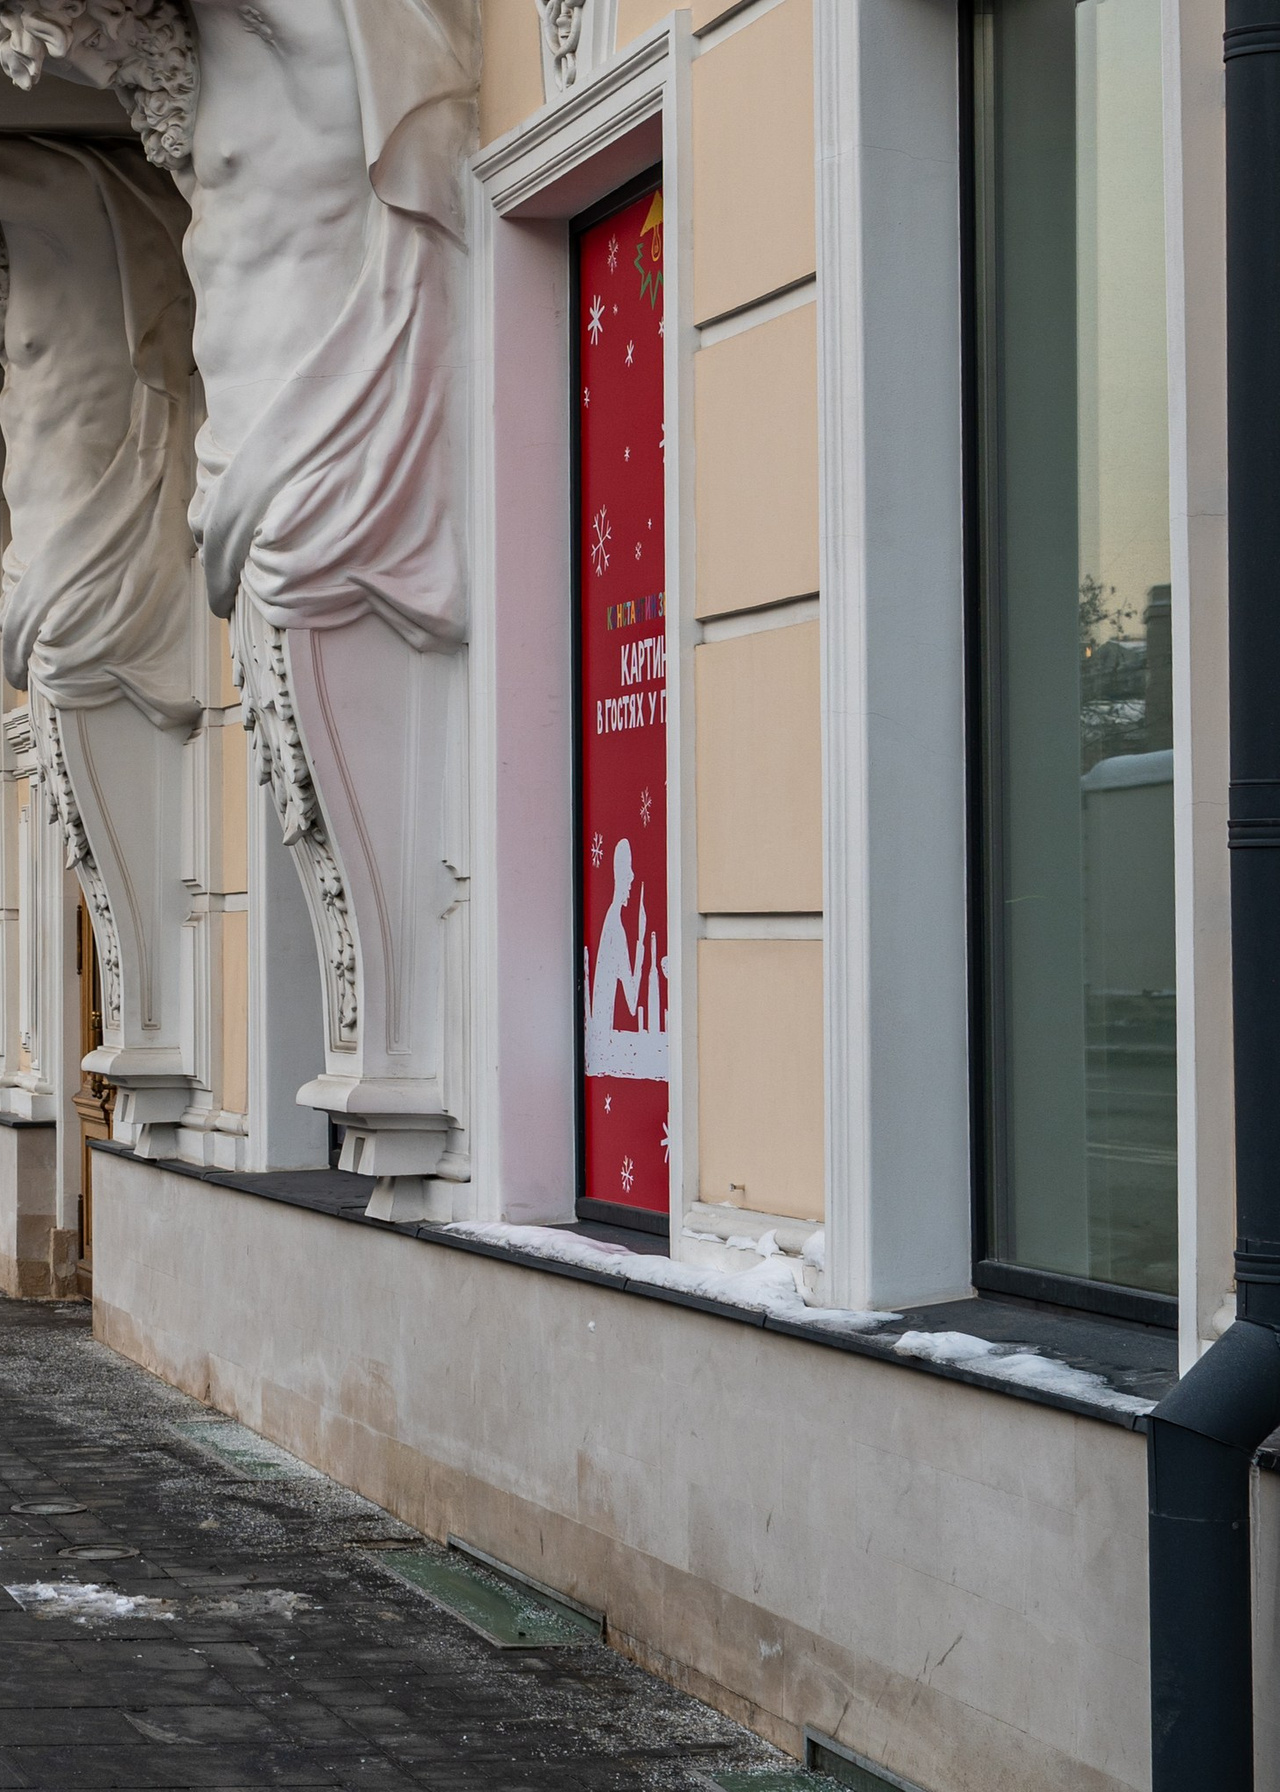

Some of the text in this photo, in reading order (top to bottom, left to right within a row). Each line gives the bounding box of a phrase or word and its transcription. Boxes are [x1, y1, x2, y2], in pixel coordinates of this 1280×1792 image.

[607, 595, 657, 630] КОНСТАНТИН
[597, 700, 603, 735] В
[605, 692, 644, 733] ГОСТЯХ
[648, 691, 657, 725] У
